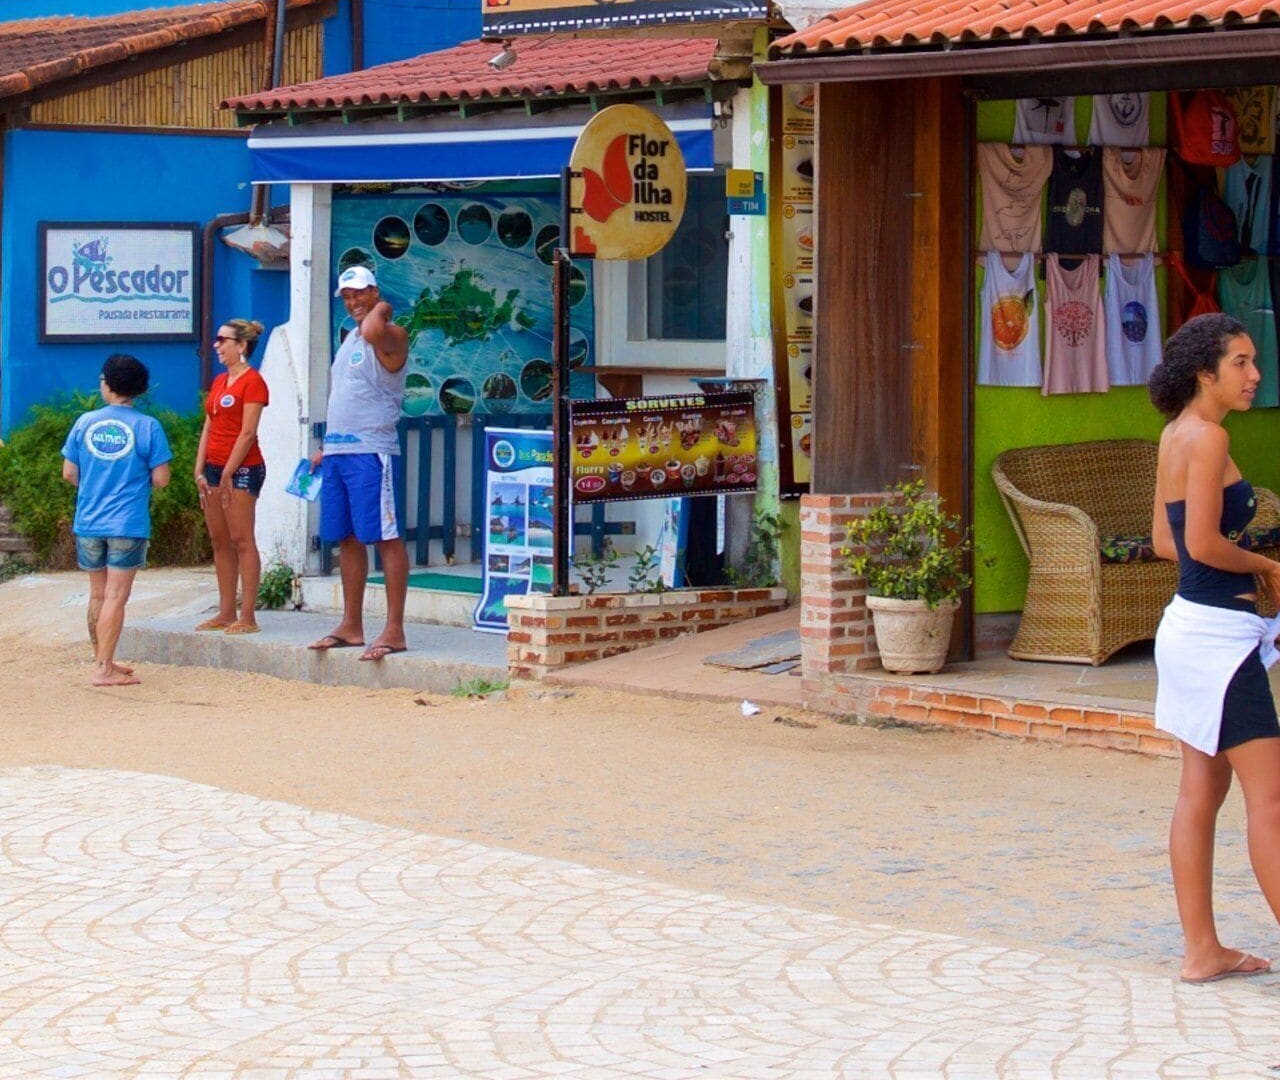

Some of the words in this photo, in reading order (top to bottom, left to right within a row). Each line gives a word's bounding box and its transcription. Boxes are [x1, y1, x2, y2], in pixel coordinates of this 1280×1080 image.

[629, 134, 670, 157] Flor
[634, 159, 659, 180] da
[634, 181, 673, 205] Ilha
[742, 201, 759, 212] TIM
[634, 211, 673, 223] HOSTEL
[48, 265, 69, 294] O
[72, 258, 189, 294] Pescador
[98, 309, 132, 320] Pousada
[139, 308, 191, 320] Restaurante
[625, 396, 706, 411] SORVETES
[576, 465, 605, 475] Flurry
